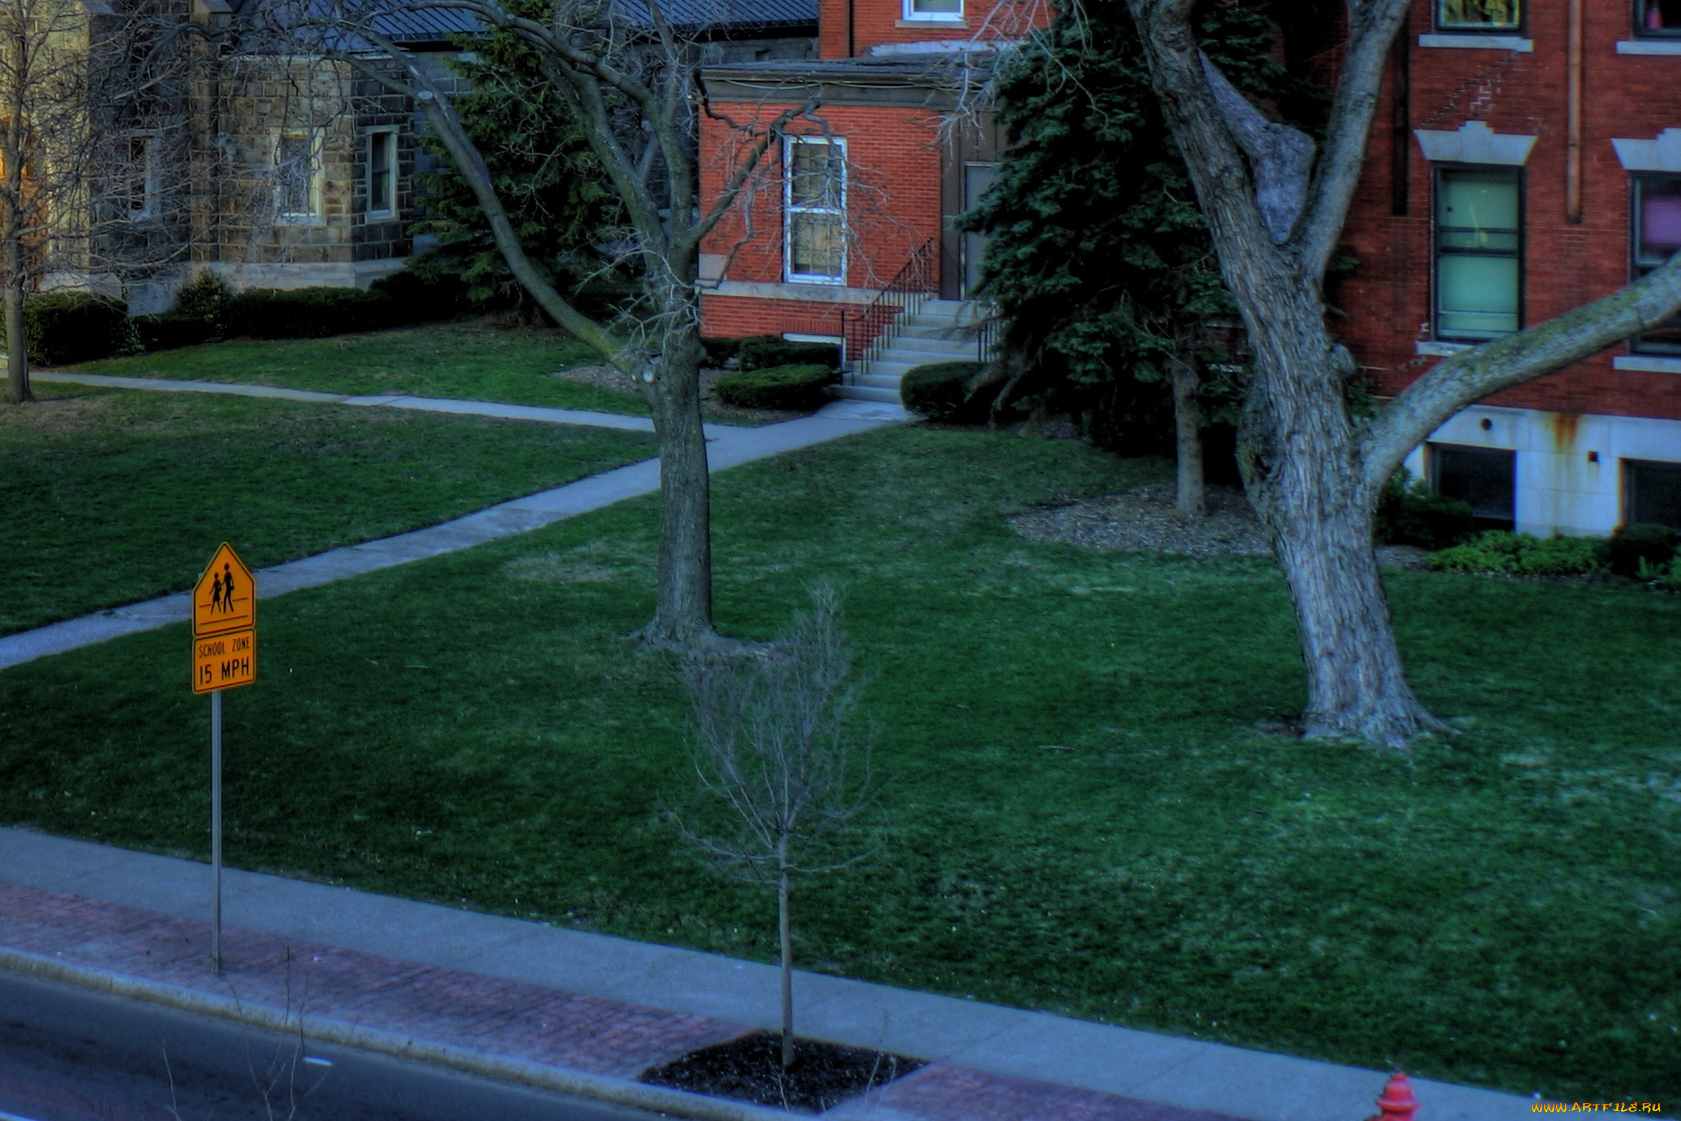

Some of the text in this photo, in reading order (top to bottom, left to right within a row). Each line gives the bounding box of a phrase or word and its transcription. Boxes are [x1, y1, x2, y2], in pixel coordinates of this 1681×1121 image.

[199, 636, 250, 658] SCHOOL ZONE
[199, 656, 249, 684] 15 MPH
